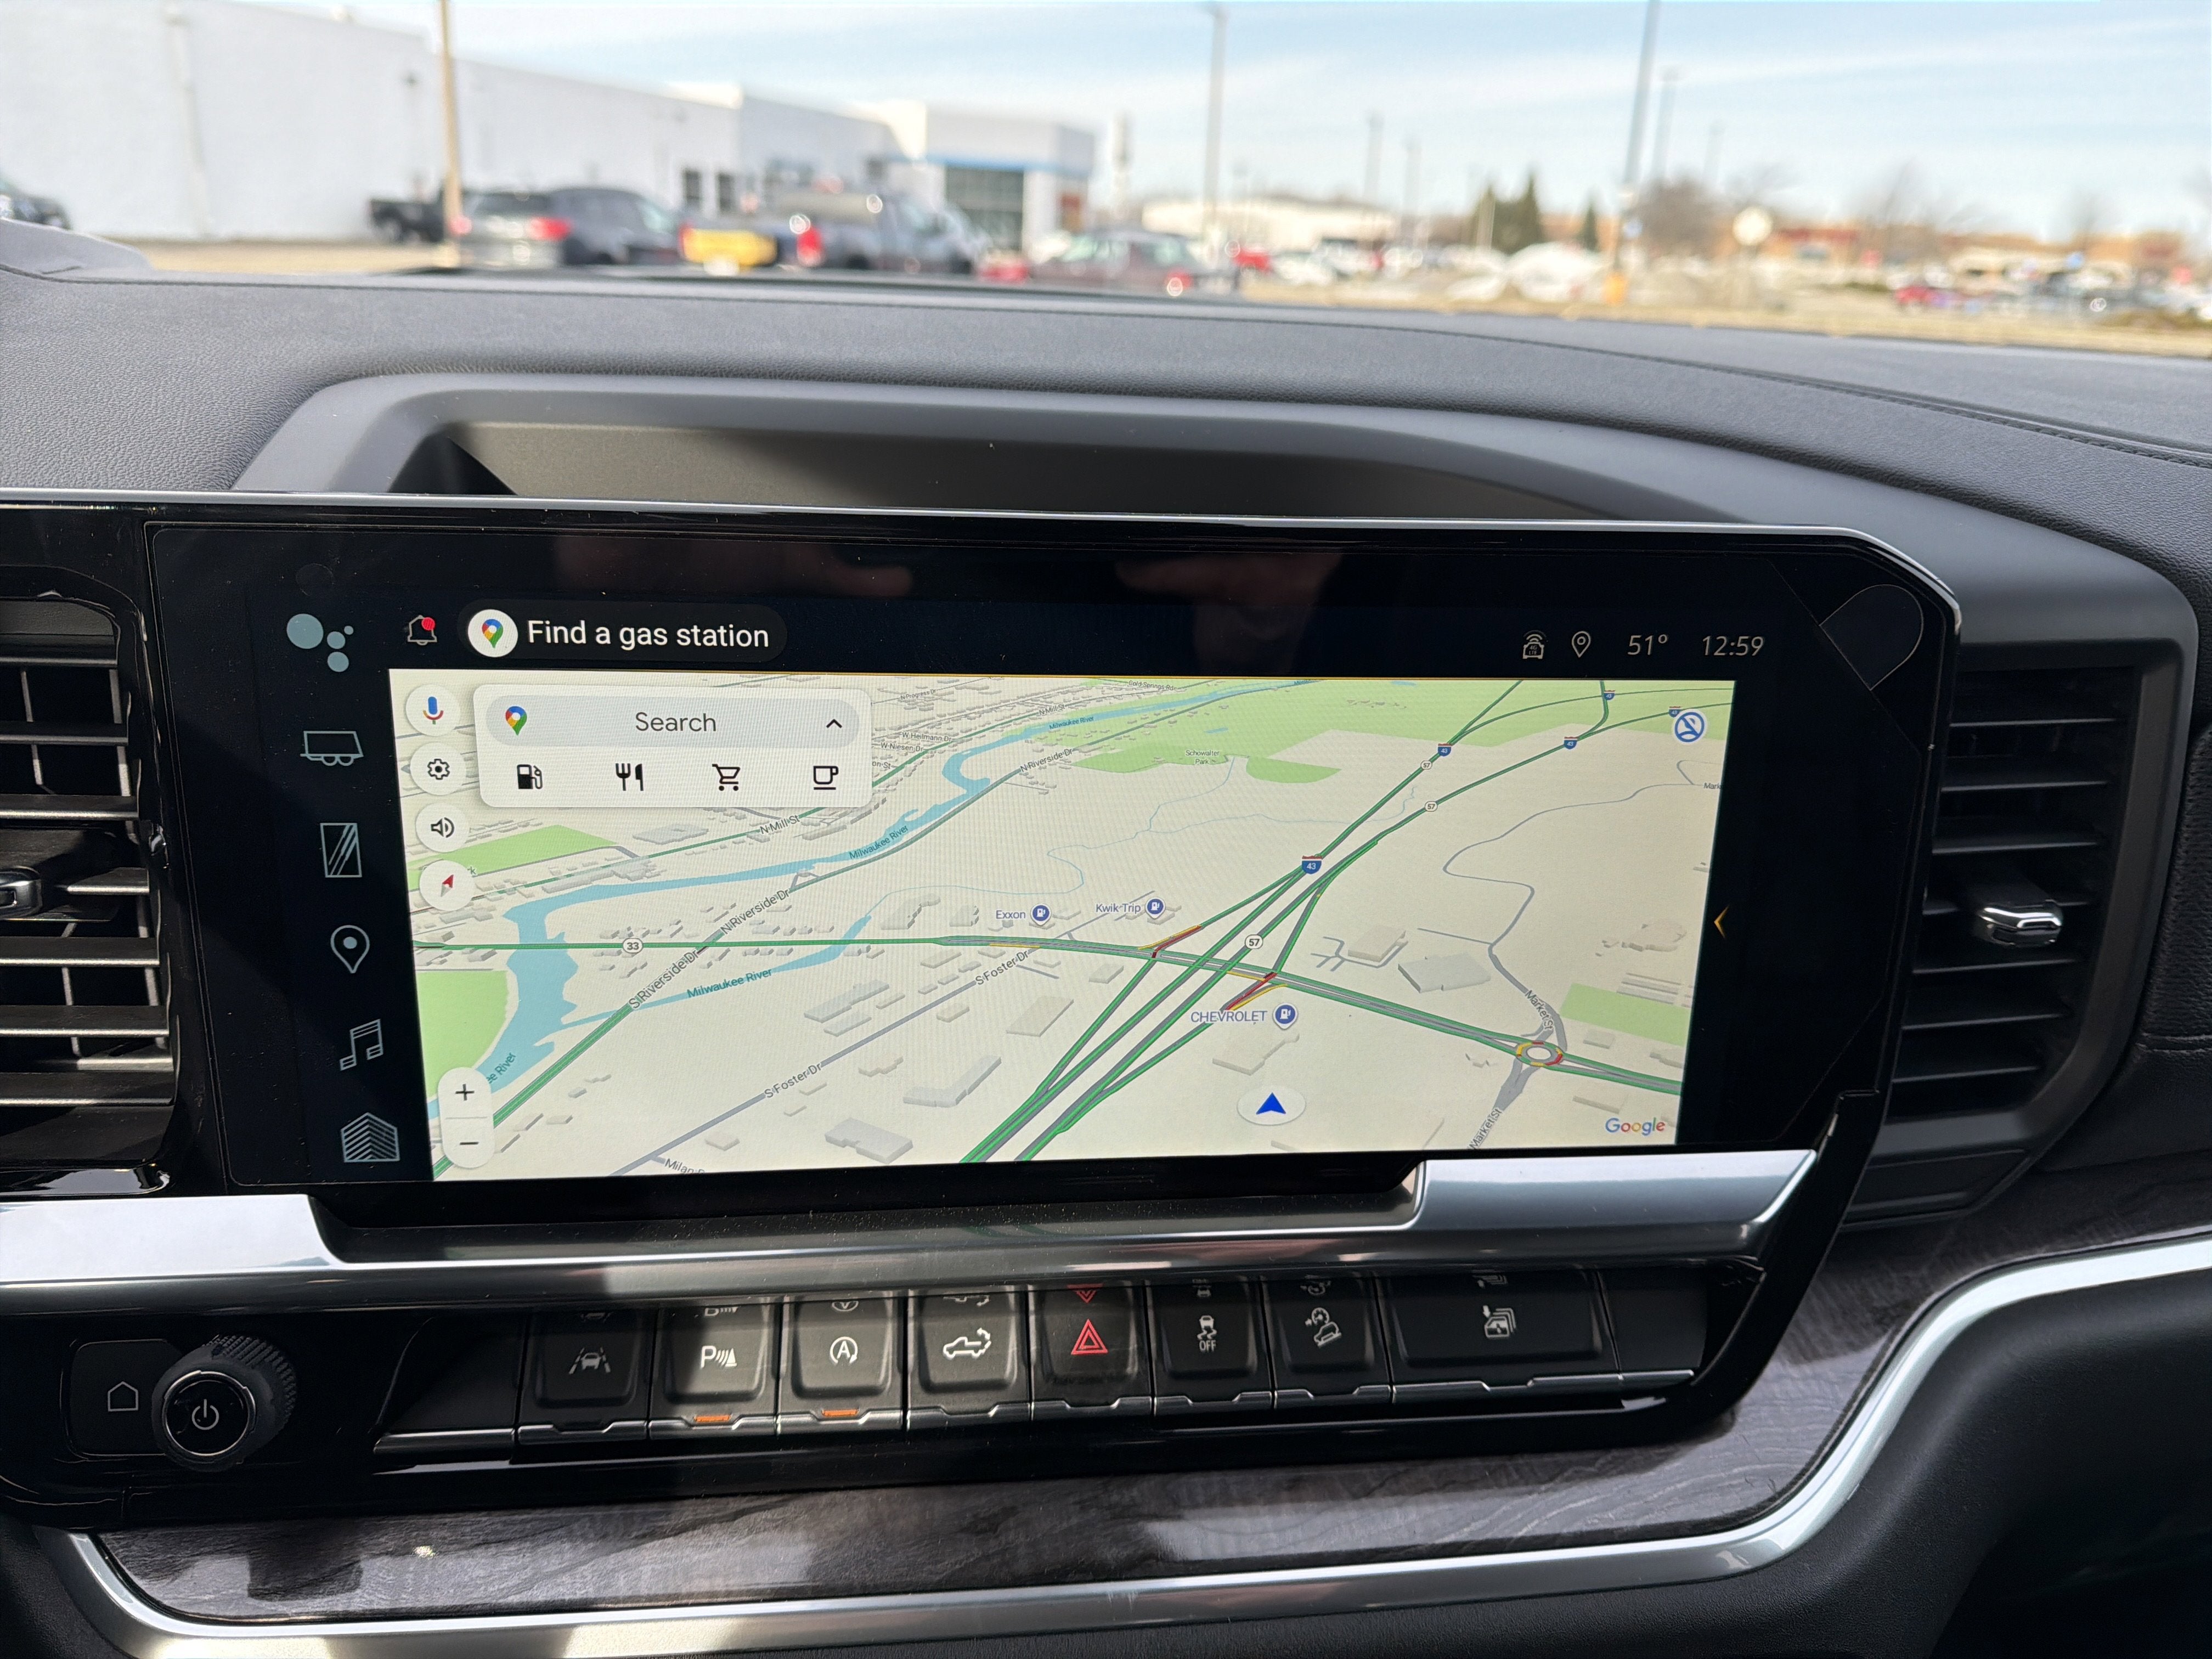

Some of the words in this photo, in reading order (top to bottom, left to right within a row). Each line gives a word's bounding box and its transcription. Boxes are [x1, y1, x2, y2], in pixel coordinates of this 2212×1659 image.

[528, 620, 586, 645] Find
[595, 627, 611, 645] a
[620, 627, 668, 650] gas
[676, 624, 769, 647] station
[1702, 635, 1764, 656] 12:59
[905, 691, 930, 699] Progress
[1142, 682, 1165, 692] Springs
[1045, 706, 1058, 714] Mill
[635, 712, 716, 732] Search
[1049, 718, 1079, 730] Milwaukee
[889, 742, 913, 751] Niesen
[1020, 763, 1028, 773] N
[1028, 751, 1064, 771] Riverside
[1063, 748, 1073, 757] Dr
[760, 826, 769, 835] N
[770, 819, 788, 832] Mill
[789, 815, 800, 825] St
[849, 837, 890, 860] Milwaukee
[889, 825, 909, 841] River
[720, 923, 732, 934] N
[730, 895, 777, 928] Riverside
[777, 889, 790, 900] Dr
[996, 910, 1026, 919] Exxon
[1096, 903, 1118, 912] Kwik
[1120, 902, 1141, 915] Trip
[627, 942, 639, 950] 33
[1249, 938, 1260, 946] 57
[975, 975, 984, 986] S
[983, 958, 1016, 982] Foster
[1015, 949, 1029, 962] Dr
[628, 998, 640, 1009] S
[637, 959, 687, 1001] Riverside
[686, 949, 699, 963] Dr
[687, 977, 744, 998] Milwaukee
[746, 967, 772, 983] River
[1190, 1011, 1267, 1023] CHEVROLET
[1525, 990, 1550, 1022] Market
[1543, 1020, 1554, 1031] St
[495, 1052, 516, 1075] River
[764, 1087, 774, 1099] S
[773, 1070, 808, 1094] Foster
[808, 1062, 822, 1075] Dr
[1469, 1118, 1496, 1150] Market
[1489, 1108, 1502, 1123] St
[1605, 1117, 1666, 1136] Google
[664, 1158, 695, 1175] Milan
[1199, 1340, 1216, 1352] OFF
